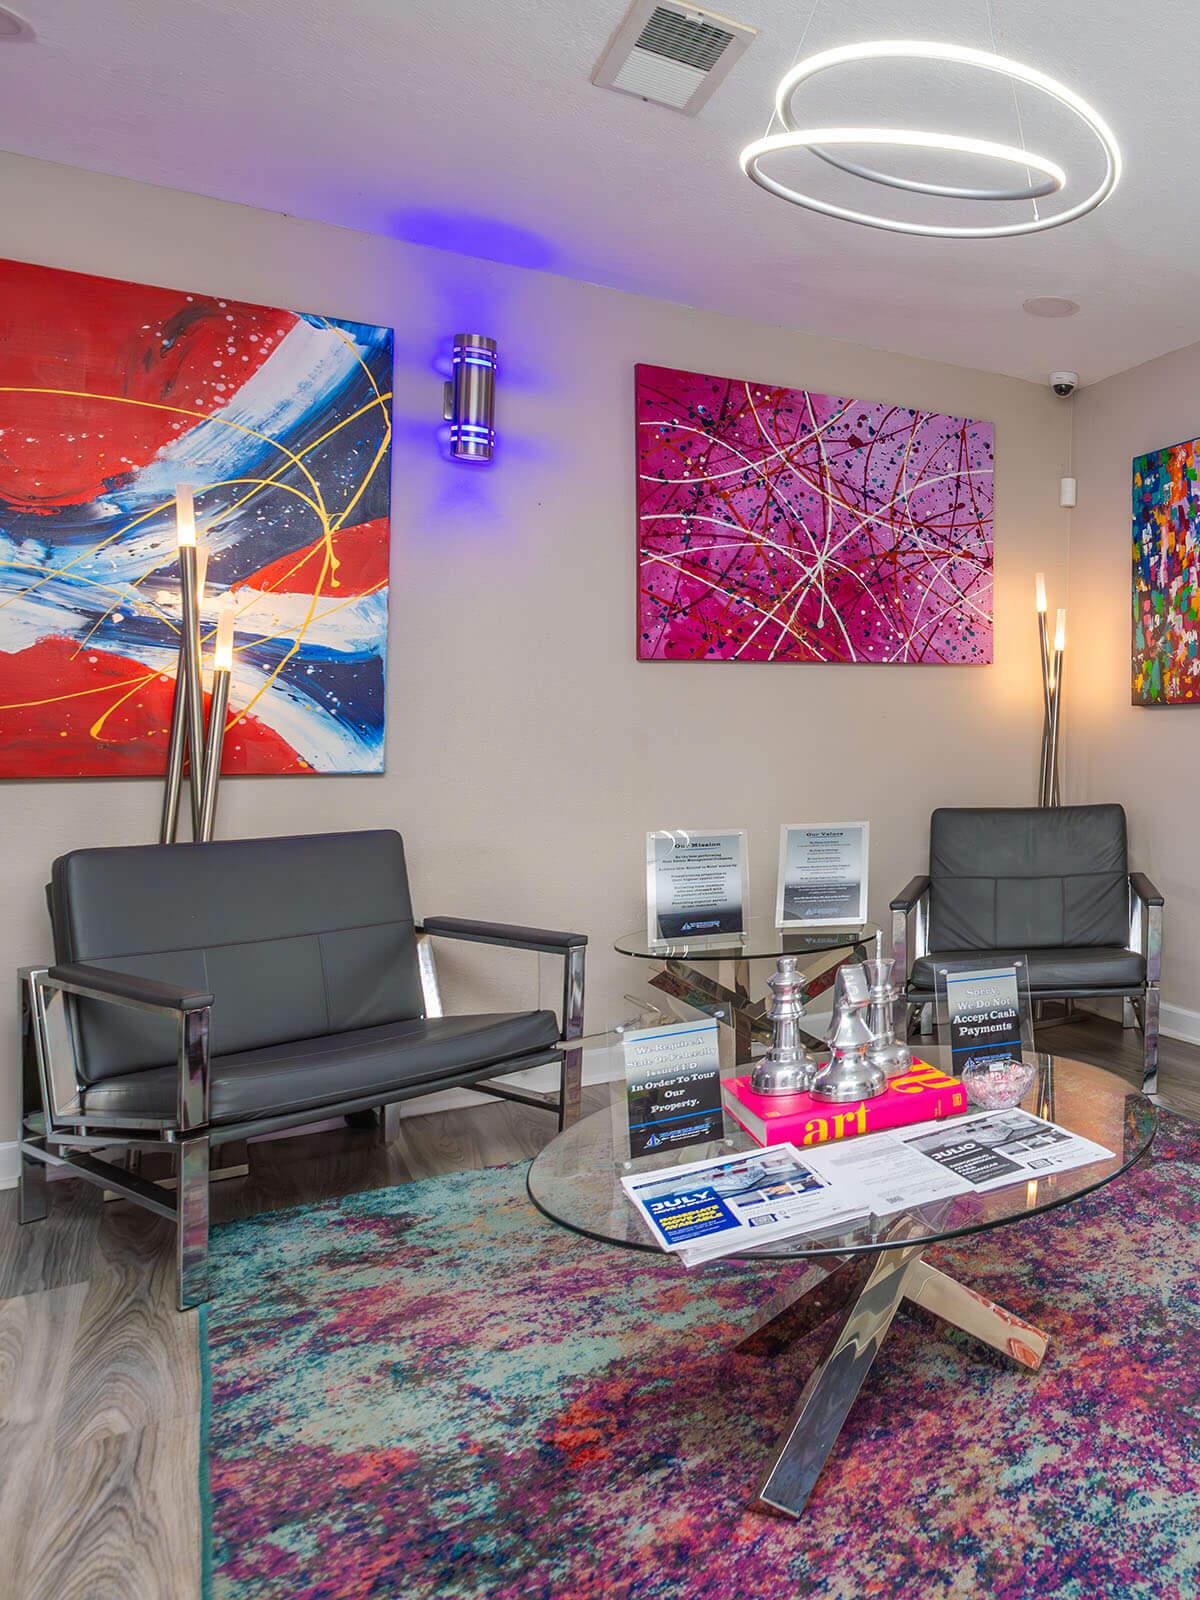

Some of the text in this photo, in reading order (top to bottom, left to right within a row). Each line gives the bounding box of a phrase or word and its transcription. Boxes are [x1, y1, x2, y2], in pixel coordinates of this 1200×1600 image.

[957, 998, 1011, 1010] We Do Not
[953, 1009, 1017, 1024] Accept Cash
[959, 1022, 1012, 1036] Payments
[636, 1046, 651, 1055] We
[646, 1064, 680, 1077] Issued
[631, 1071, 716, 1092] In Order To Tour
[664, 1089, 686, 1098] Our
[650, 1098, 700, 1114] Property.
[803, 1102, 871, 1145] art
[931, 1142, 976, 1160] JULIO
[650, 1191, 710, 1212] JULY
